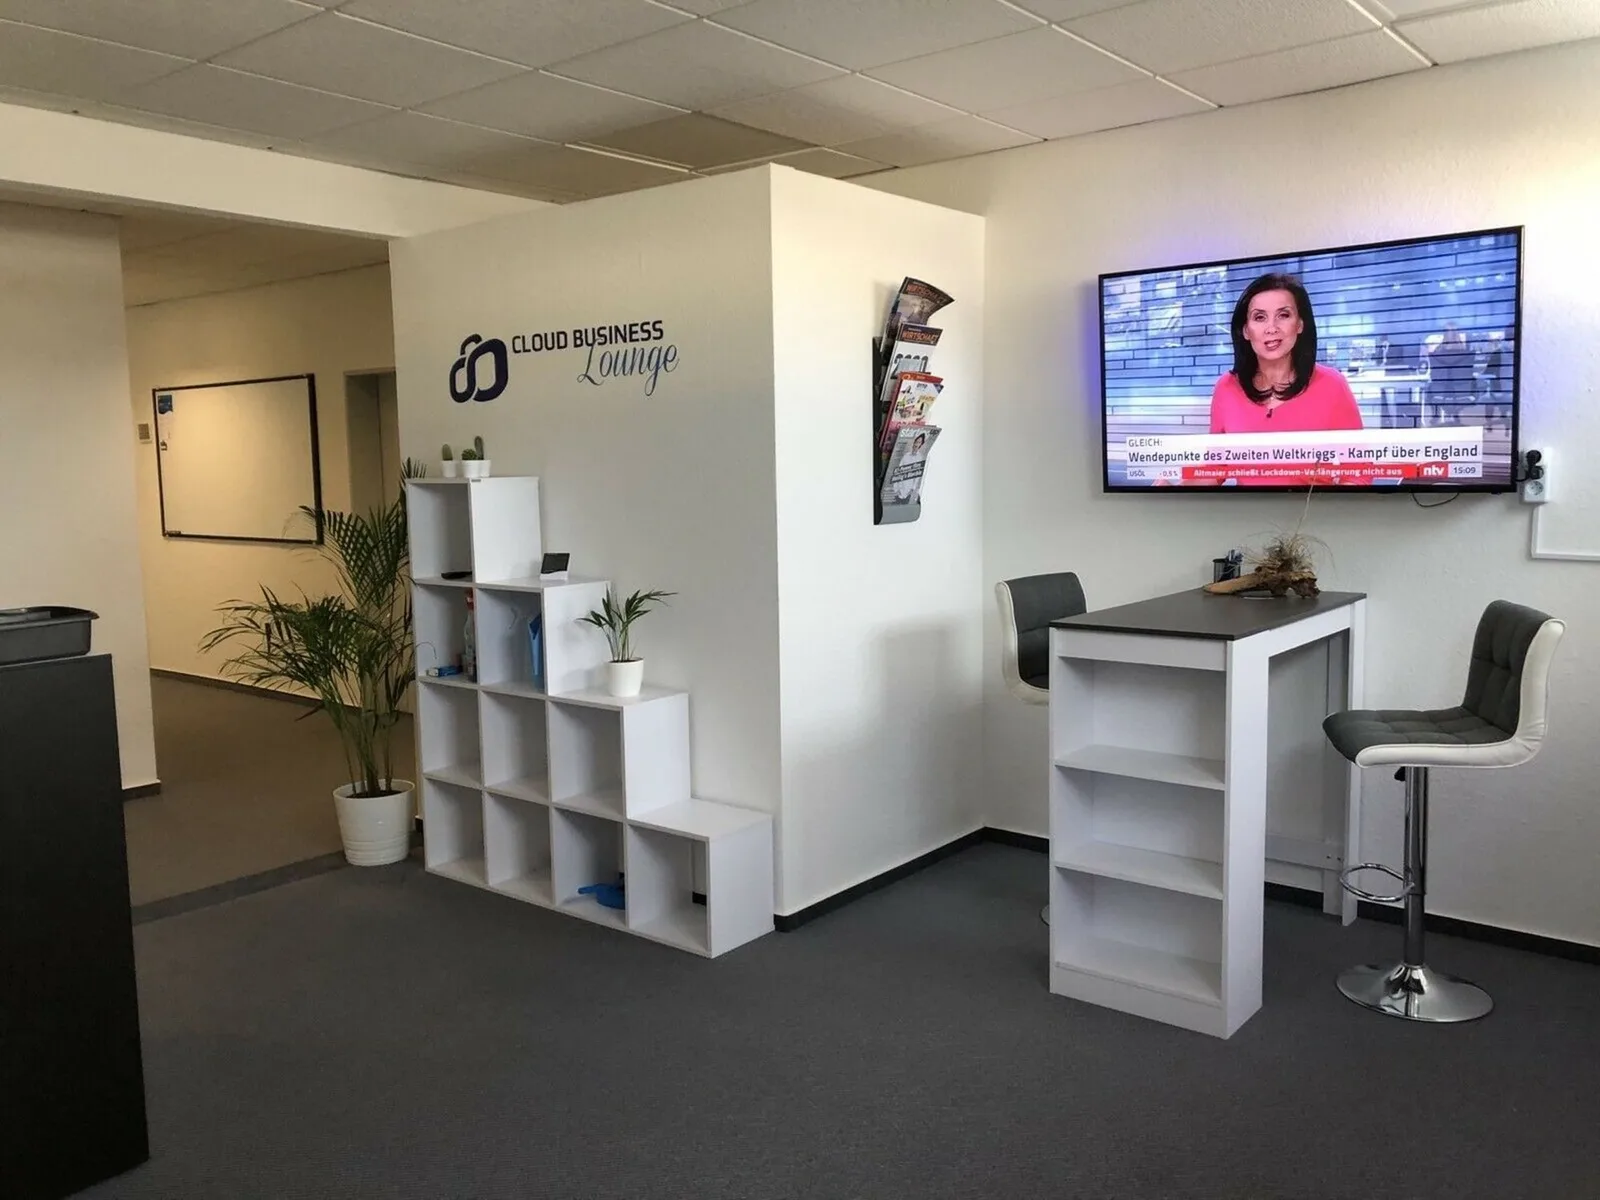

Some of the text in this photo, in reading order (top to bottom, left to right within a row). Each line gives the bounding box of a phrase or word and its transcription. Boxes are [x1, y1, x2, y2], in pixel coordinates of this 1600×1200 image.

[512, 319, 664, 354] CLOUD BUSINESS
[577, 338, 680, 396] Lounge
[1128, 438, 1163, 448] GLEICH:
[1128, 451, 1200, 464] Wendepunkte
[1203, 450, 1222, 461] des
[1225, 449, 1269, 461] Zweiten
[1273, 447, 1336, 462] Weltkriegs
[1348, 447, 1387, 460] Kampf
[1391, 445, 1421, 458] über
[1424, 444, 1478, 460] England
[1193, 467, 1403, 479] Altmaier schließt Lockdown-Velängerung nicht aus
[1423, 465, 1446, 476] ntv
[1453, 466, 1477, 475] 15:09
